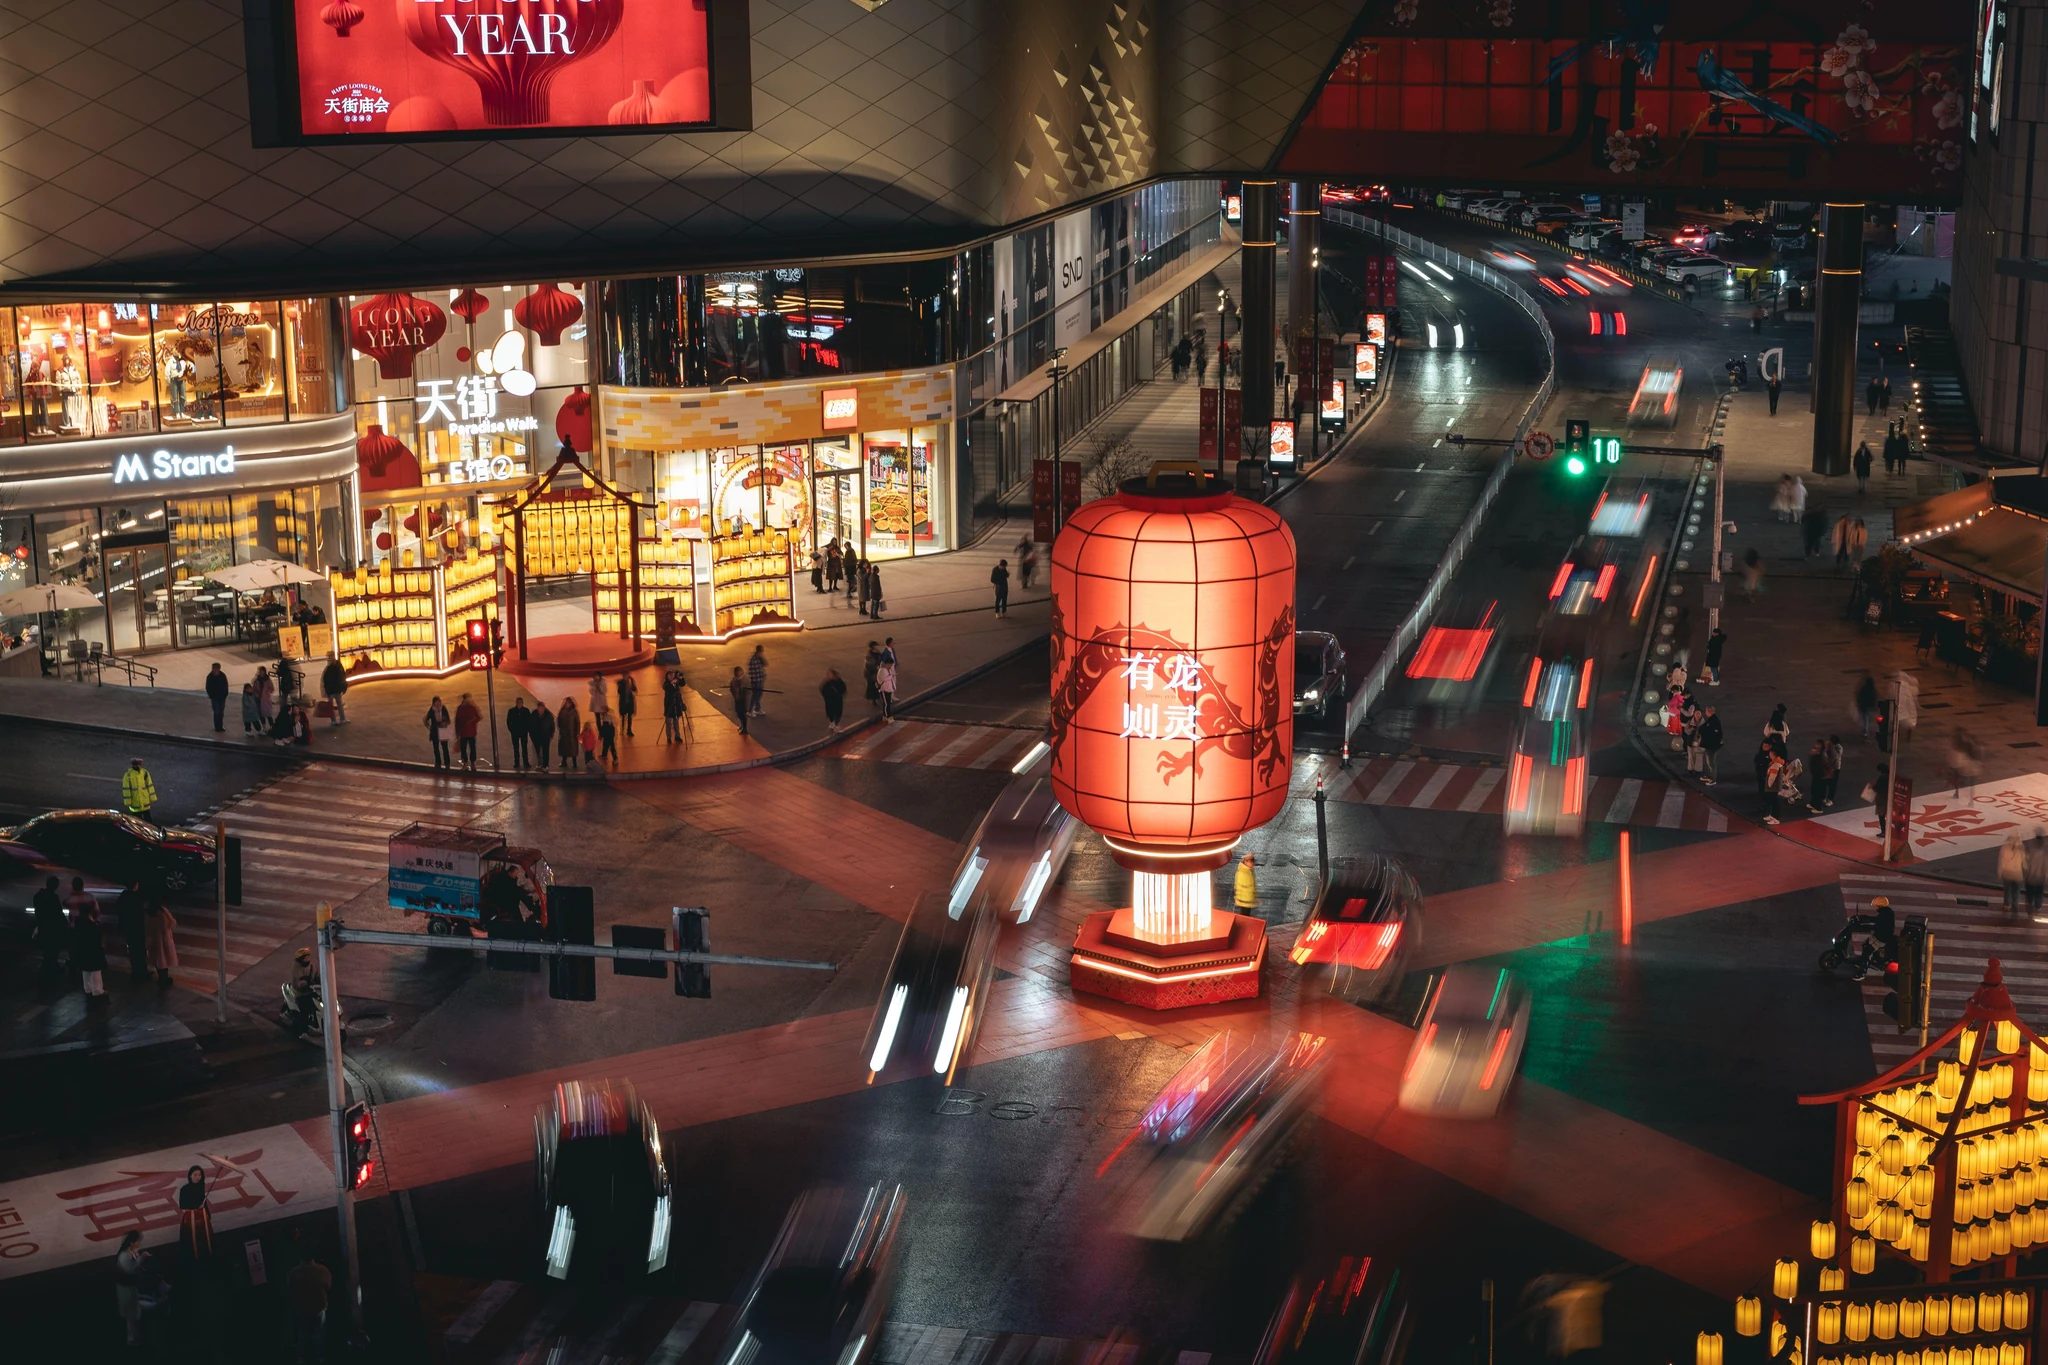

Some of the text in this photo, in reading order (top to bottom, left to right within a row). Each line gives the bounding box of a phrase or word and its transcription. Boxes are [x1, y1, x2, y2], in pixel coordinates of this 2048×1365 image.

[440, 13, 576, 55] YEAR
[331, 85, 348, 95] HAPPY
[369, 85, 382, 94] YEAR
[324, 96, 390, 115] 天街庙会
[1062, 256, 1083, 289] SND
[366, 326, 426, 348] YEAR
[415, 375, 499, 424] 天街
[825, 398, 857, 419] LEGO
[448, 416, 538, 436] Paradise Walk
[1593, 438, 1620, 463] 10
[114, 445, 234, 484] M Stand
[1120, 651, 1203, 692] 有龙
[1119, 702, 1203, 741] 则灵
[416, 857, 454, 871] 重庆快递
